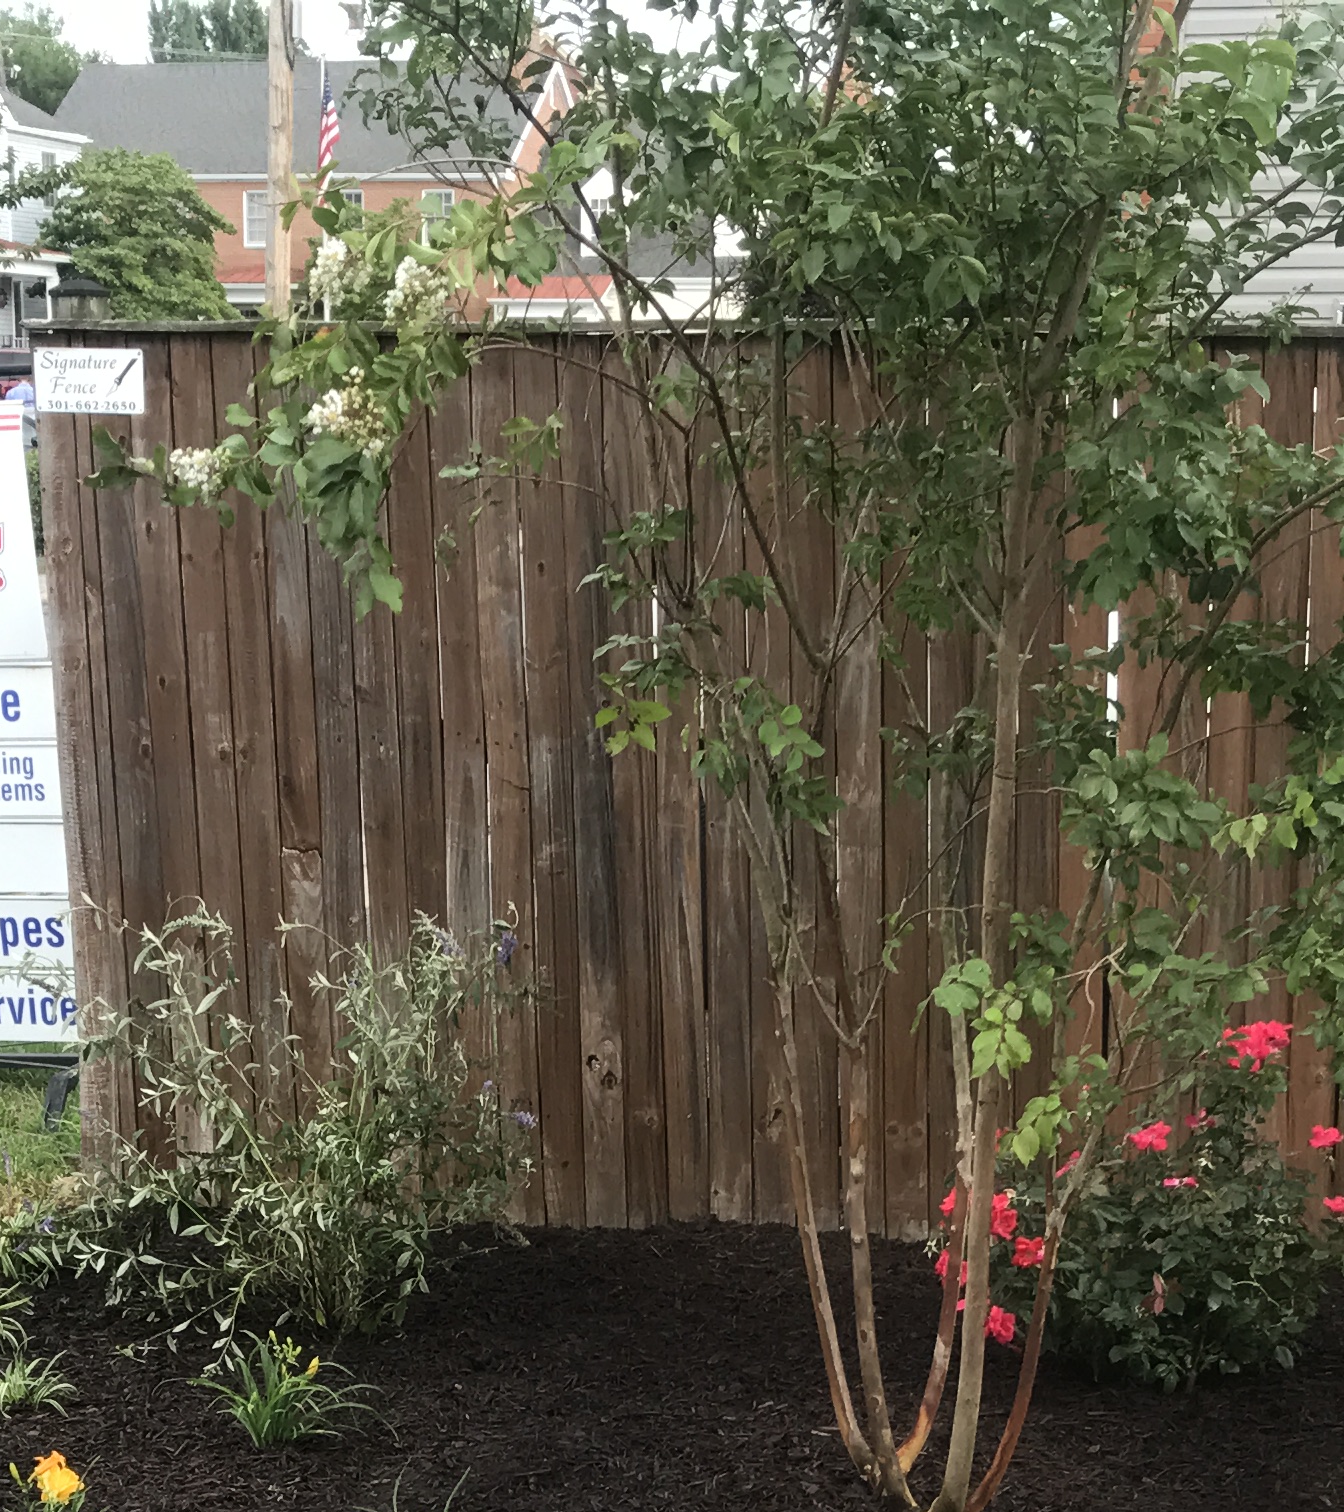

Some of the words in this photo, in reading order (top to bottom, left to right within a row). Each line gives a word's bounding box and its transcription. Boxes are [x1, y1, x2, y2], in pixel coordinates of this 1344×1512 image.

[40, 350, 117, 375] Signature
[50, 376, 97, 394] Fence
[47, 400, 136, 411] 301-662-2650
